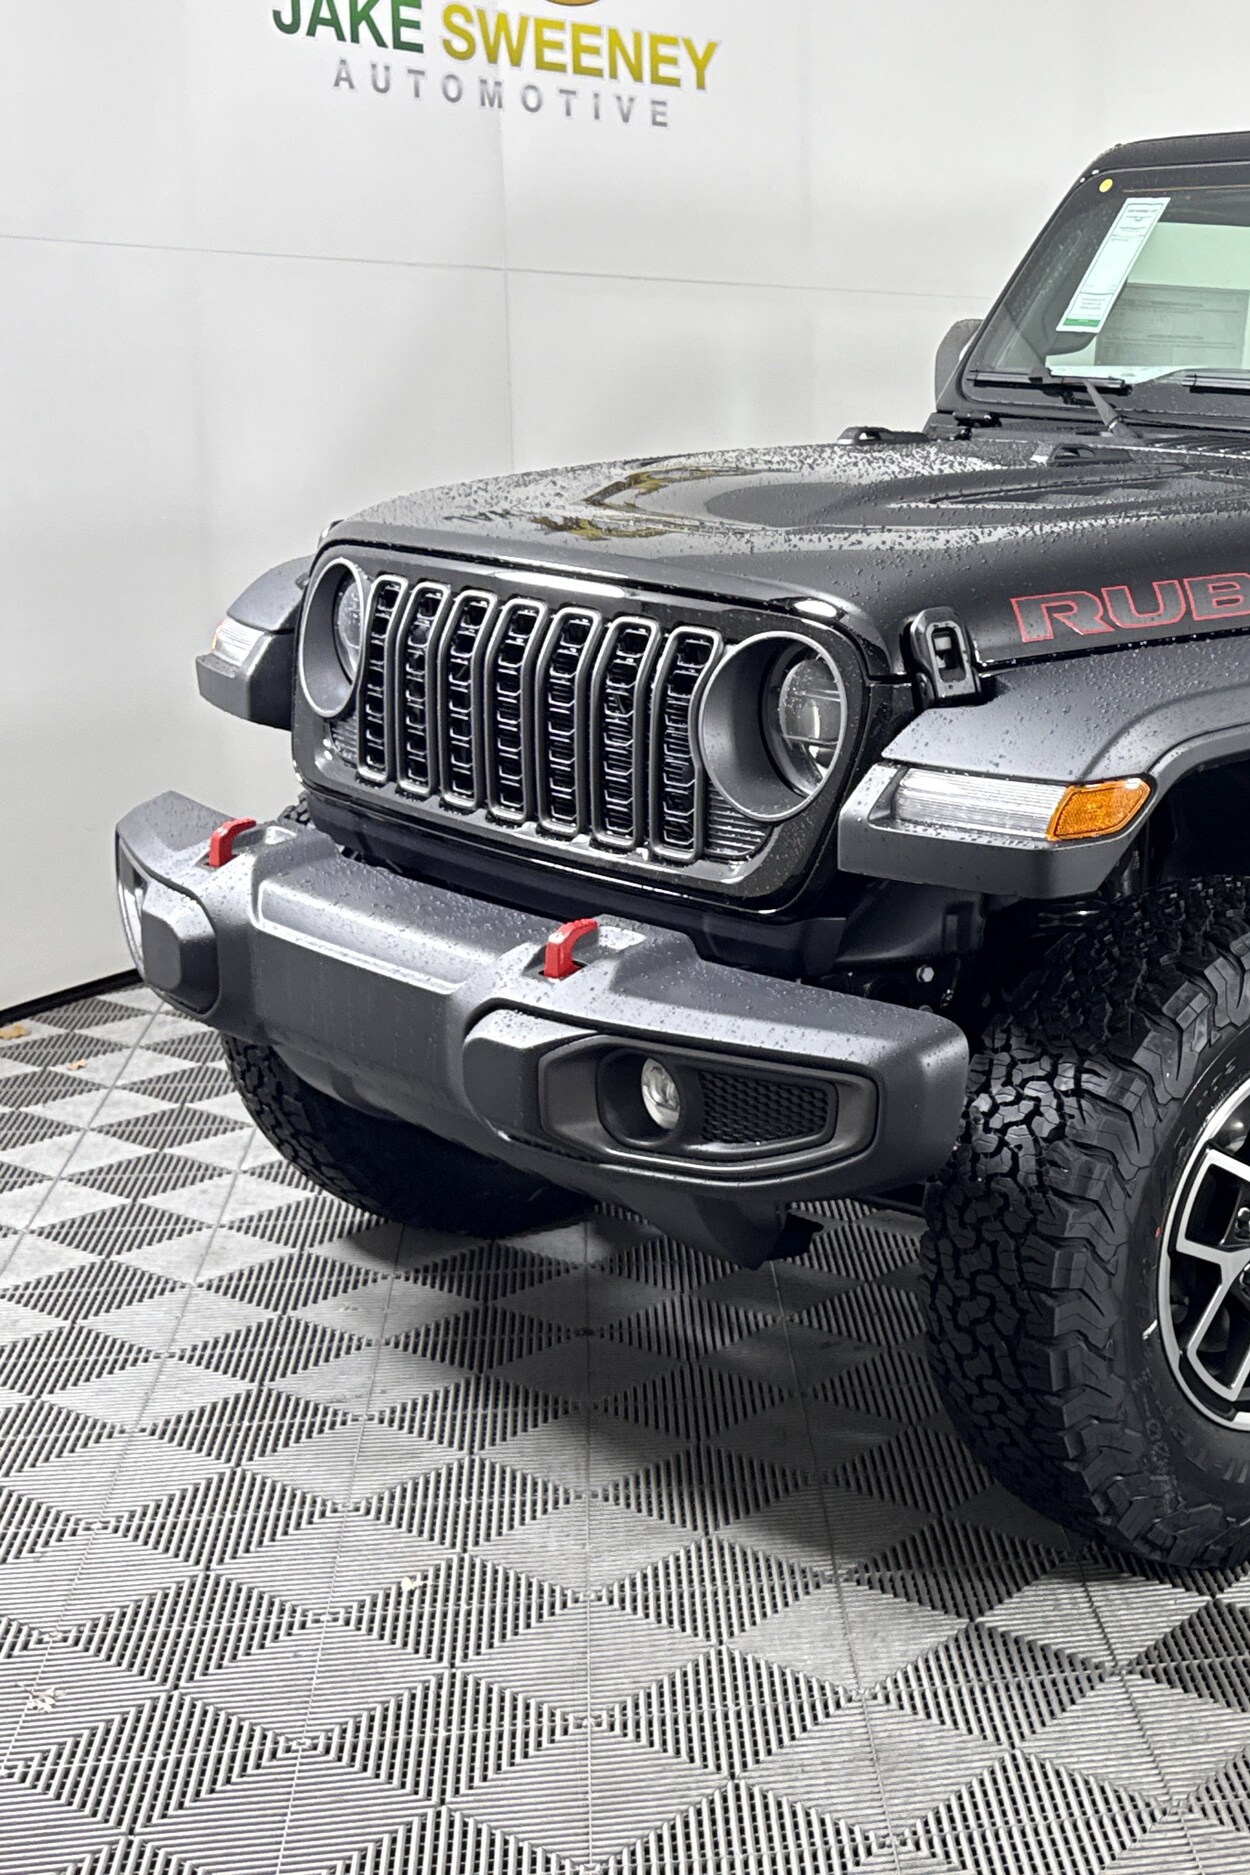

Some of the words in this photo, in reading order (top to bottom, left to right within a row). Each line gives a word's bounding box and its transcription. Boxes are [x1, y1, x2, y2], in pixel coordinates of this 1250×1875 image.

[272, 0, 425, 54] JAKE
[442, 4, 717, 90] SWEENEY
[333, 59, 669, 128] AUTOMOTIVE
